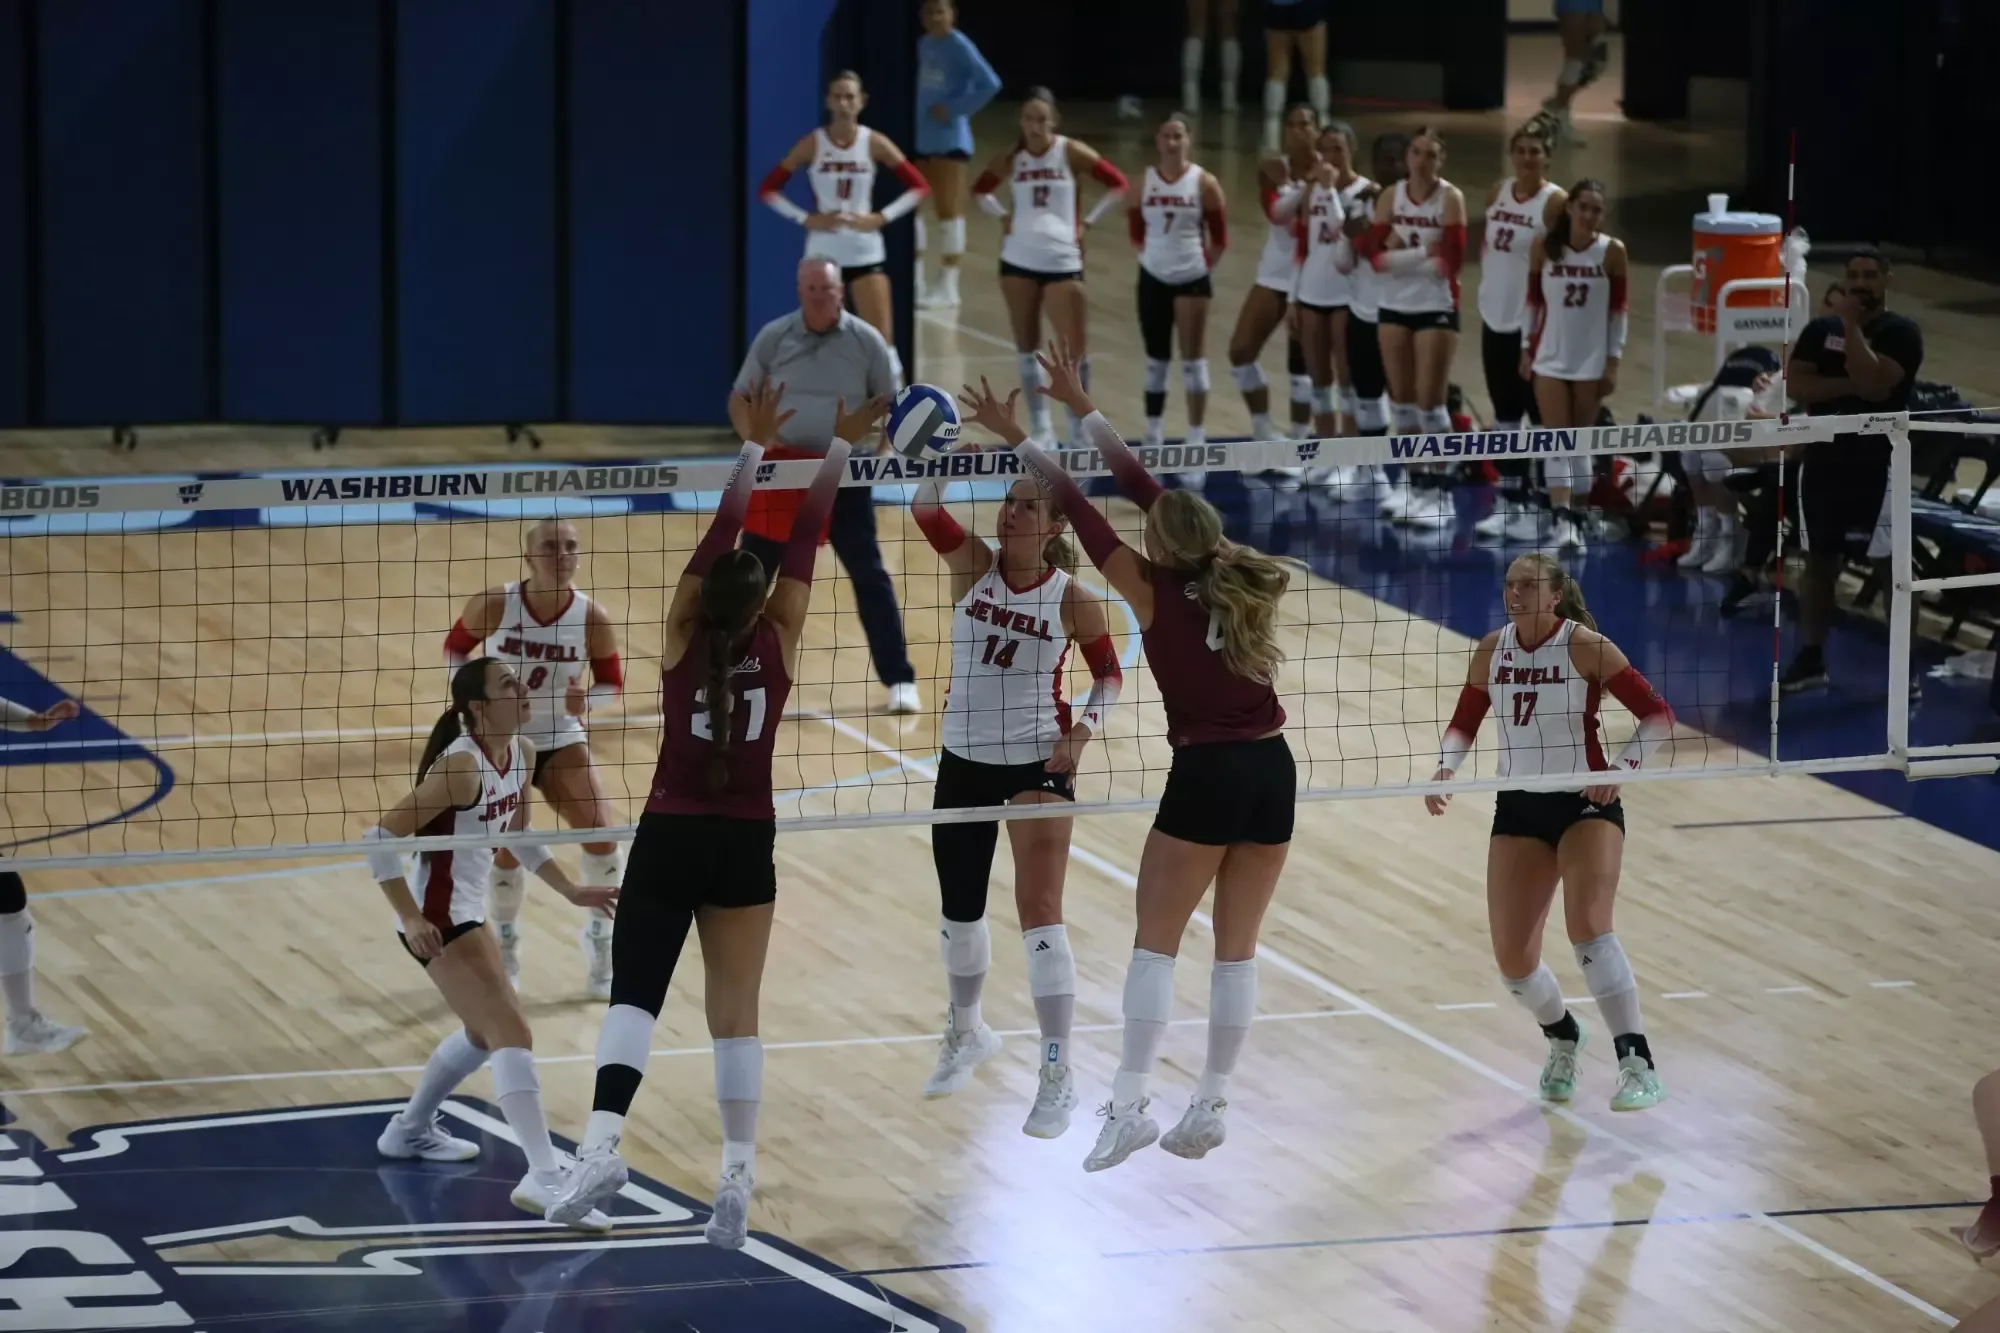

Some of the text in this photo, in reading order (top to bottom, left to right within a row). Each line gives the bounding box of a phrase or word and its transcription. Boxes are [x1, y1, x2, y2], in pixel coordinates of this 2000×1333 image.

[1564, 283, 1590, 308] 23
[1389, 422, 1753, 459] WASHBURN ICHABODS
[850, 445, 1228, 481] WASHBUR ICHBODS
[0, 485, 100, 511] BODS
[281, 466, 680, 502] WASHBURN ICHABODS
[965, 598, 1053, 643] JEWELL
[497, 636, 578, 662] JEWELL
[981, 634, 1020, 669] 14
[1494, 665, 1566, 685] JEWELL
[1512, 691, 1538, 727] 17
[478, 791, 518, 821] JEWE
